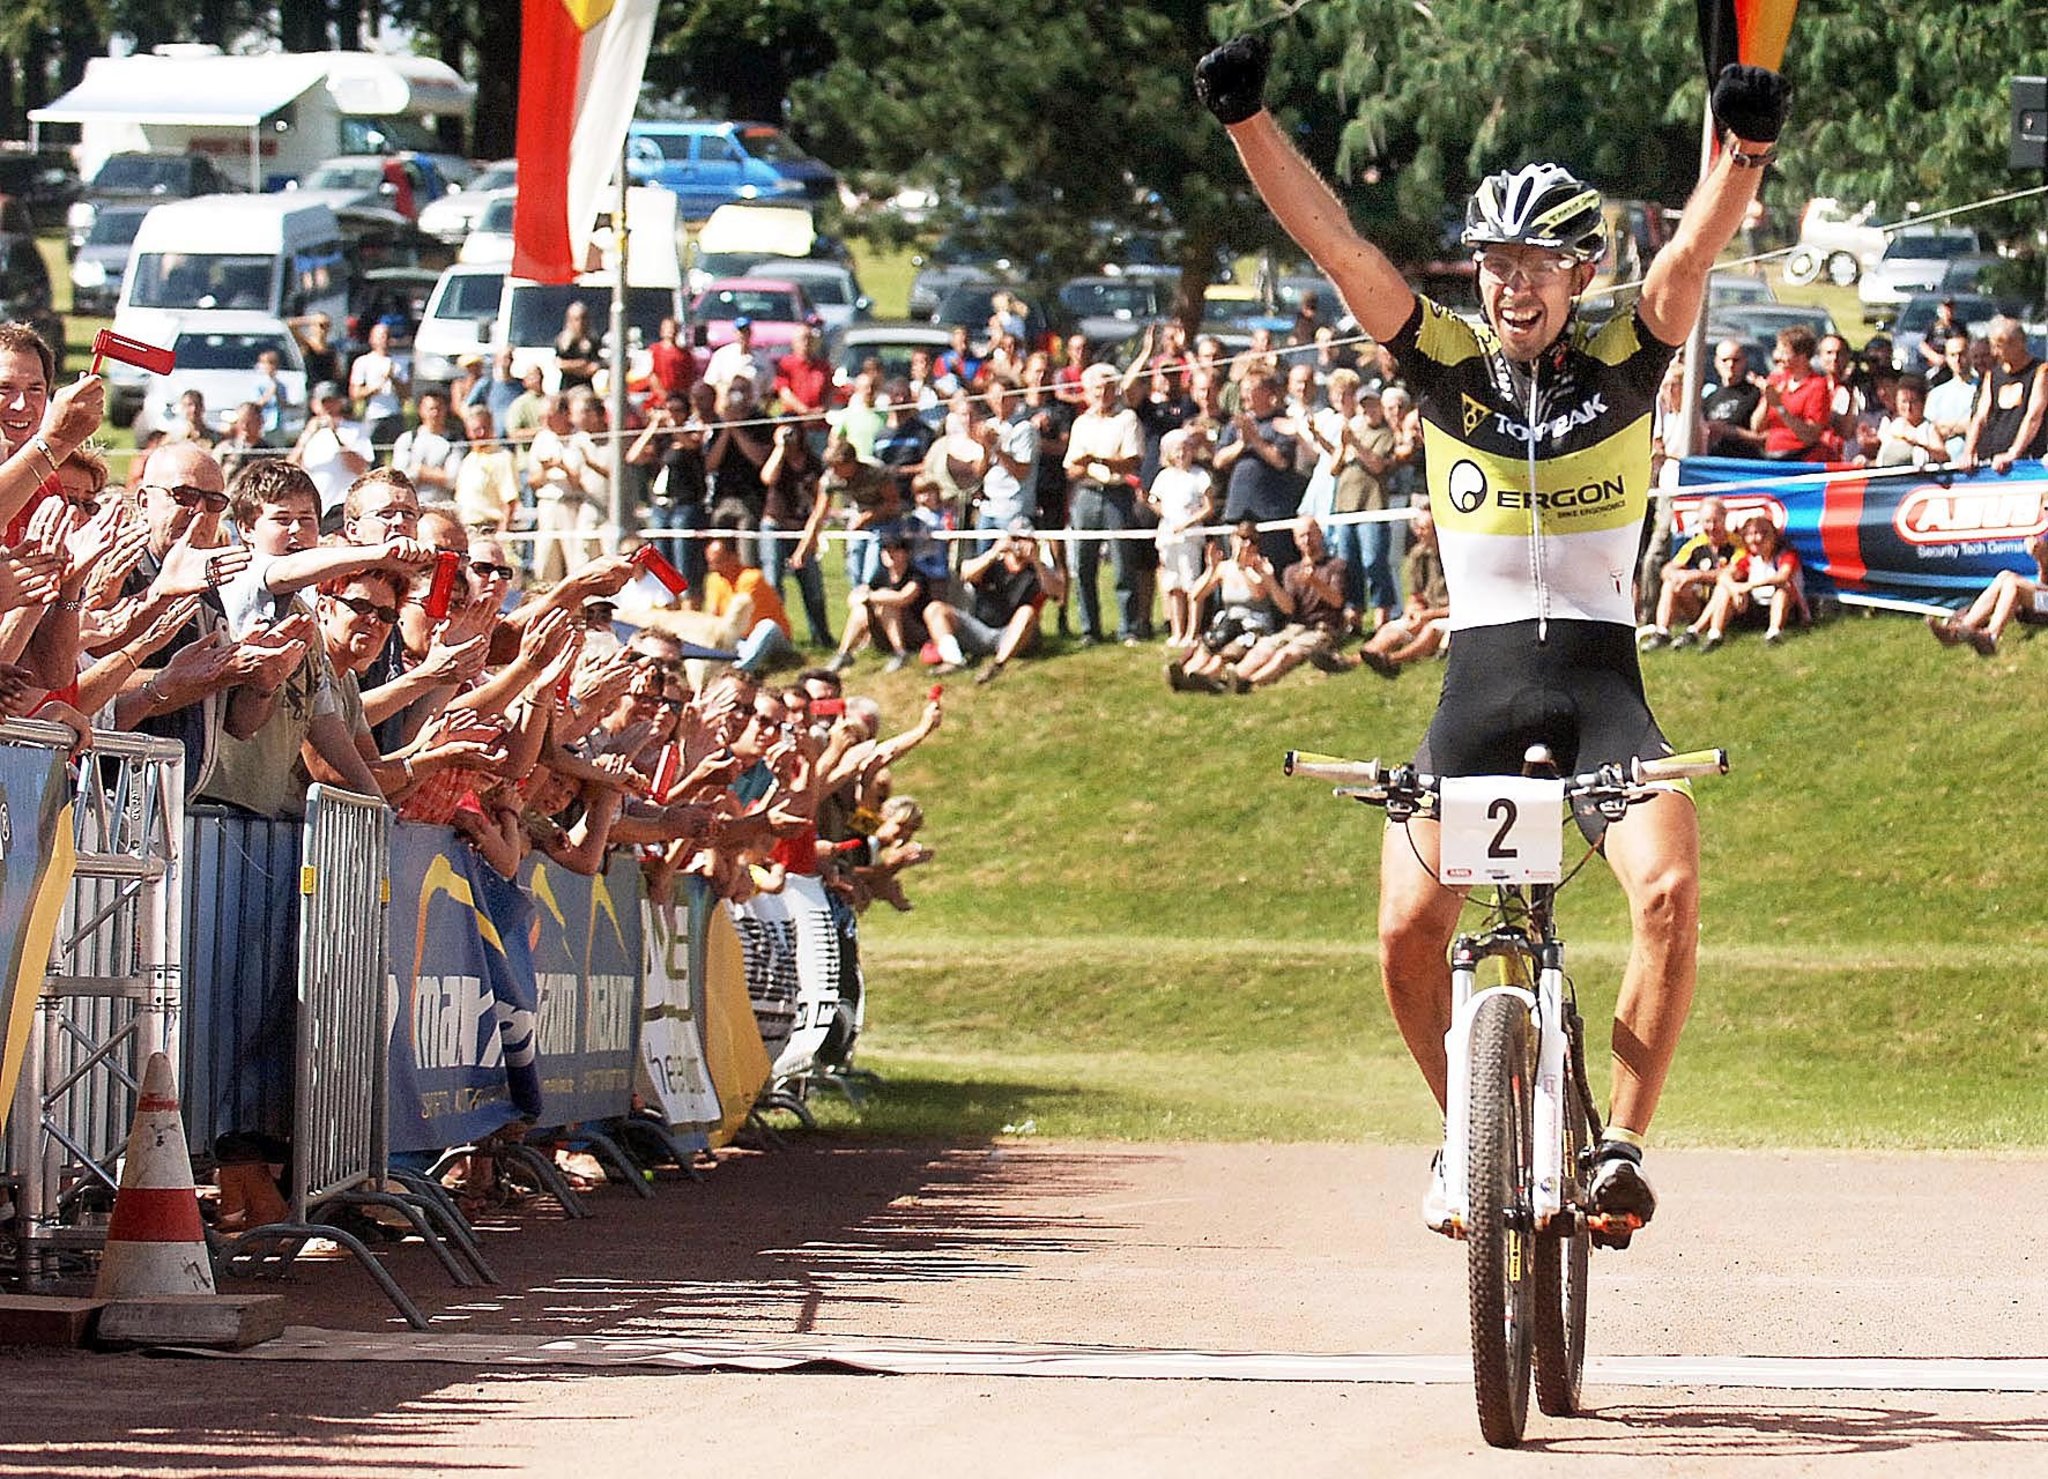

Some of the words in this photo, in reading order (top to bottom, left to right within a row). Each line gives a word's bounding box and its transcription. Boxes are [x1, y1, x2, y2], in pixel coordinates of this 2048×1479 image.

[1494, 393, 1609, 442] TOPEAK
[1497, 475, 1625, 509] ERGON
[1917, 543, 1960, 559] Security
[1961, 542, 1986, 555] Tech
[1487, 797, 1518, 859] 2
